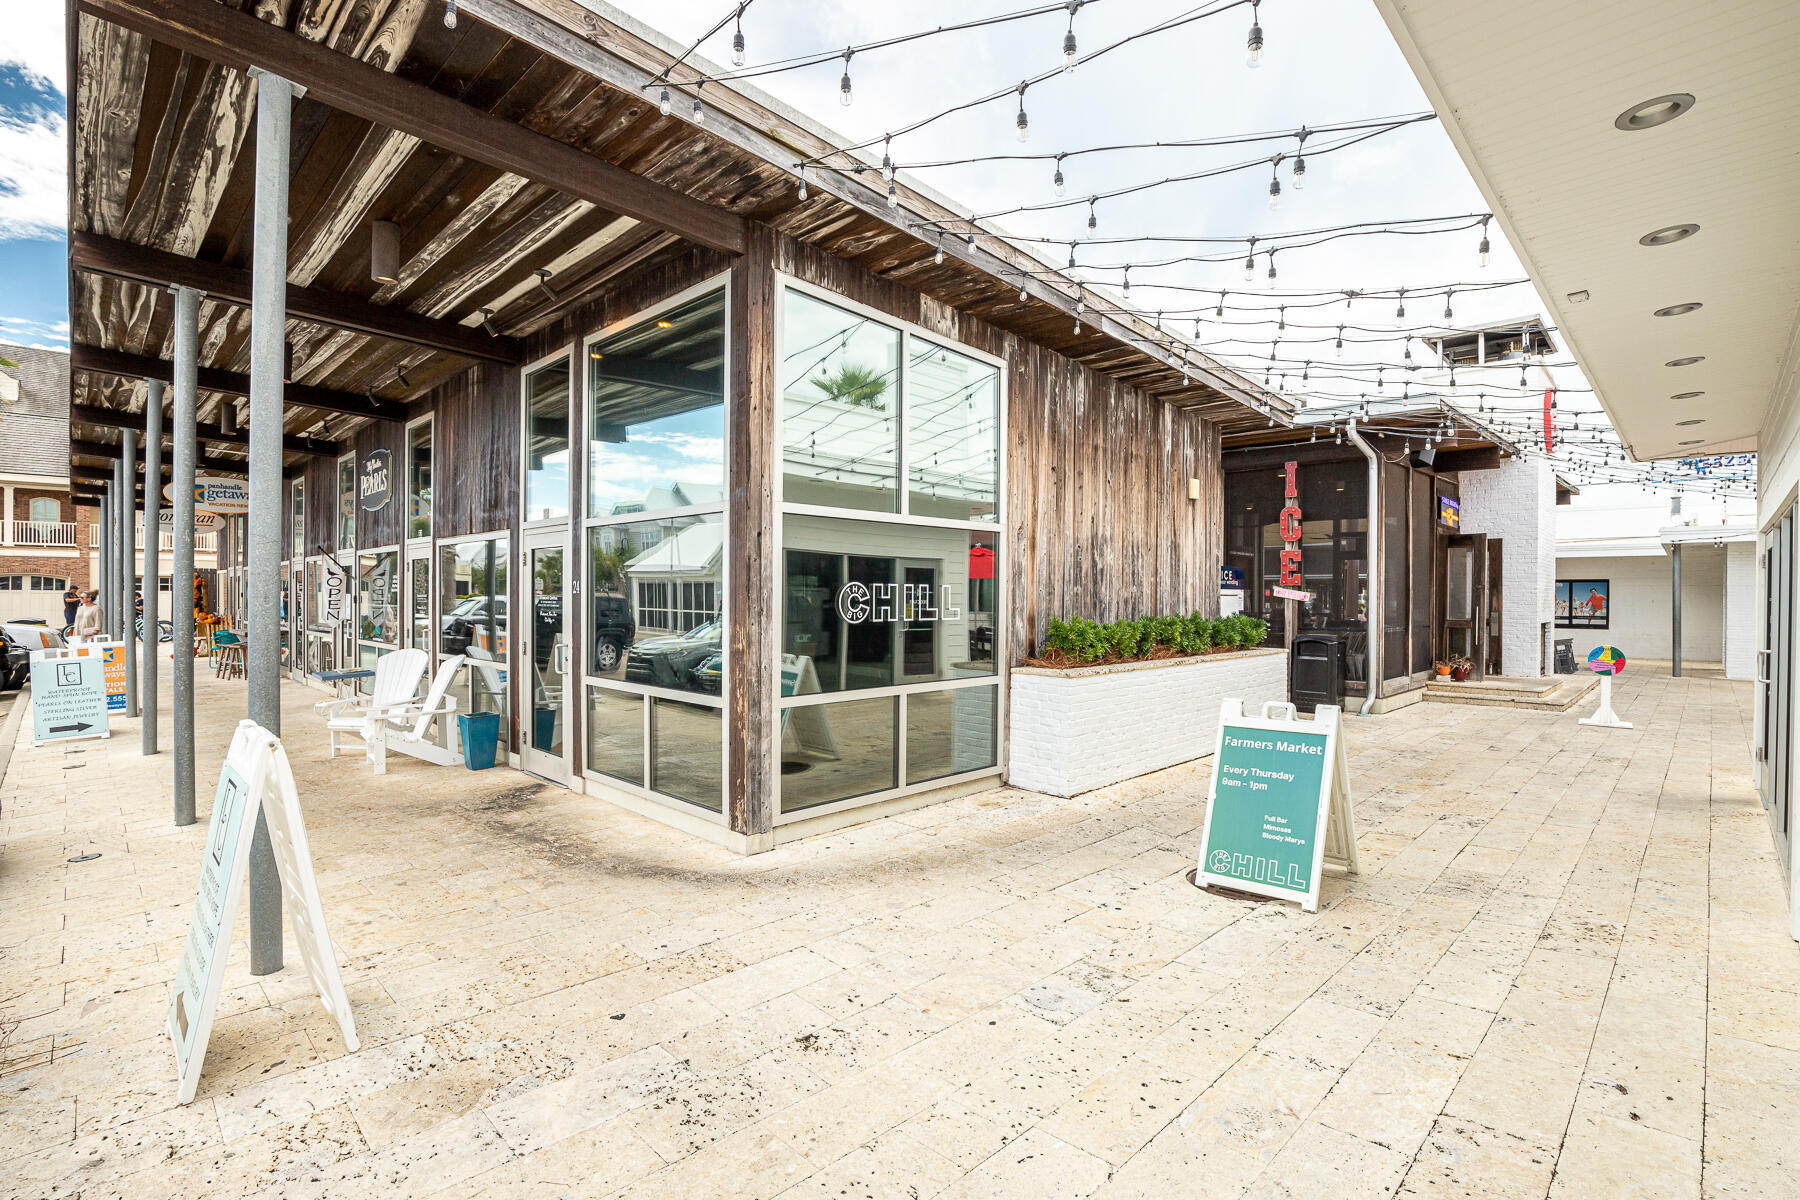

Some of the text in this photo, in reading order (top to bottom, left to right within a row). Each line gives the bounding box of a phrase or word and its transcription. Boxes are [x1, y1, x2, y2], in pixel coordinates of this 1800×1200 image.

[360, 469, 387, 499] PEARLS
[1280, 461, 1302, 586] ICE
[572, 580, 580, 594] 24
[846, 585, 864, 597] THE
[327, 577, 342, 621] OPEN
[839, 581, 961, 624] CHILL
[846, 610, 863, 621] BIG
[1224, 736, 1323, 755] Farmers Market
[1223, 764, 1295, 782] Every Thursday
[1222, 777, 1241, 787] 9am
[1249, 780, 1268, 790] 1pm
[1263, 823, 1292, 833] Mimosas
[1276, 816, 1288, 824] Bar
[1262, 832, 1305, 845] Bloody Marys
[1209, 849, 1306, 889] CHILL
